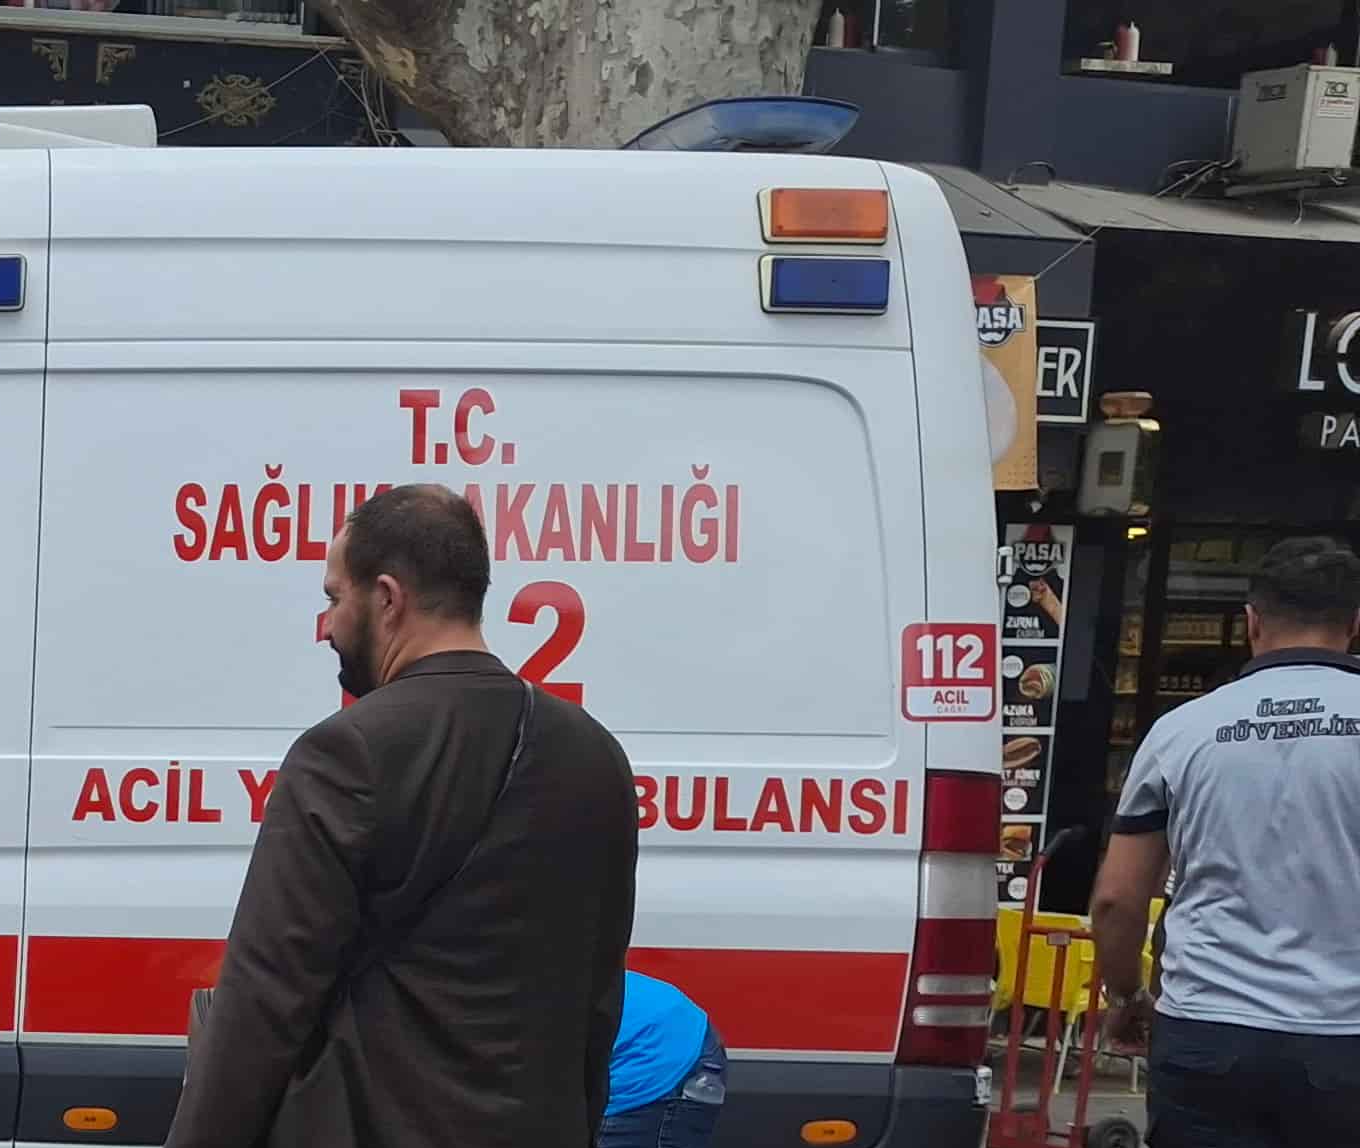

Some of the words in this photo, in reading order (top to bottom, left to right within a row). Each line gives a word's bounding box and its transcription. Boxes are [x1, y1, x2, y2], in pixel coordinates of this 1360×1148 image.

[977, 306, 1023, 329] ASA
[399, 387, 515, 465] T.C.
[173, 463, 392, 562] SAĞLI
[464, 463, 739, 563] KANLIĞI
[916, 633, 985, 679] 112
[1215, 713, 1360, 743] GÜVENLİK
[1256, 697, 1325, 718] ÖZEL
[72, 760, 222, 822] ACİL
[633, 775, 909, 835] BULANSI
